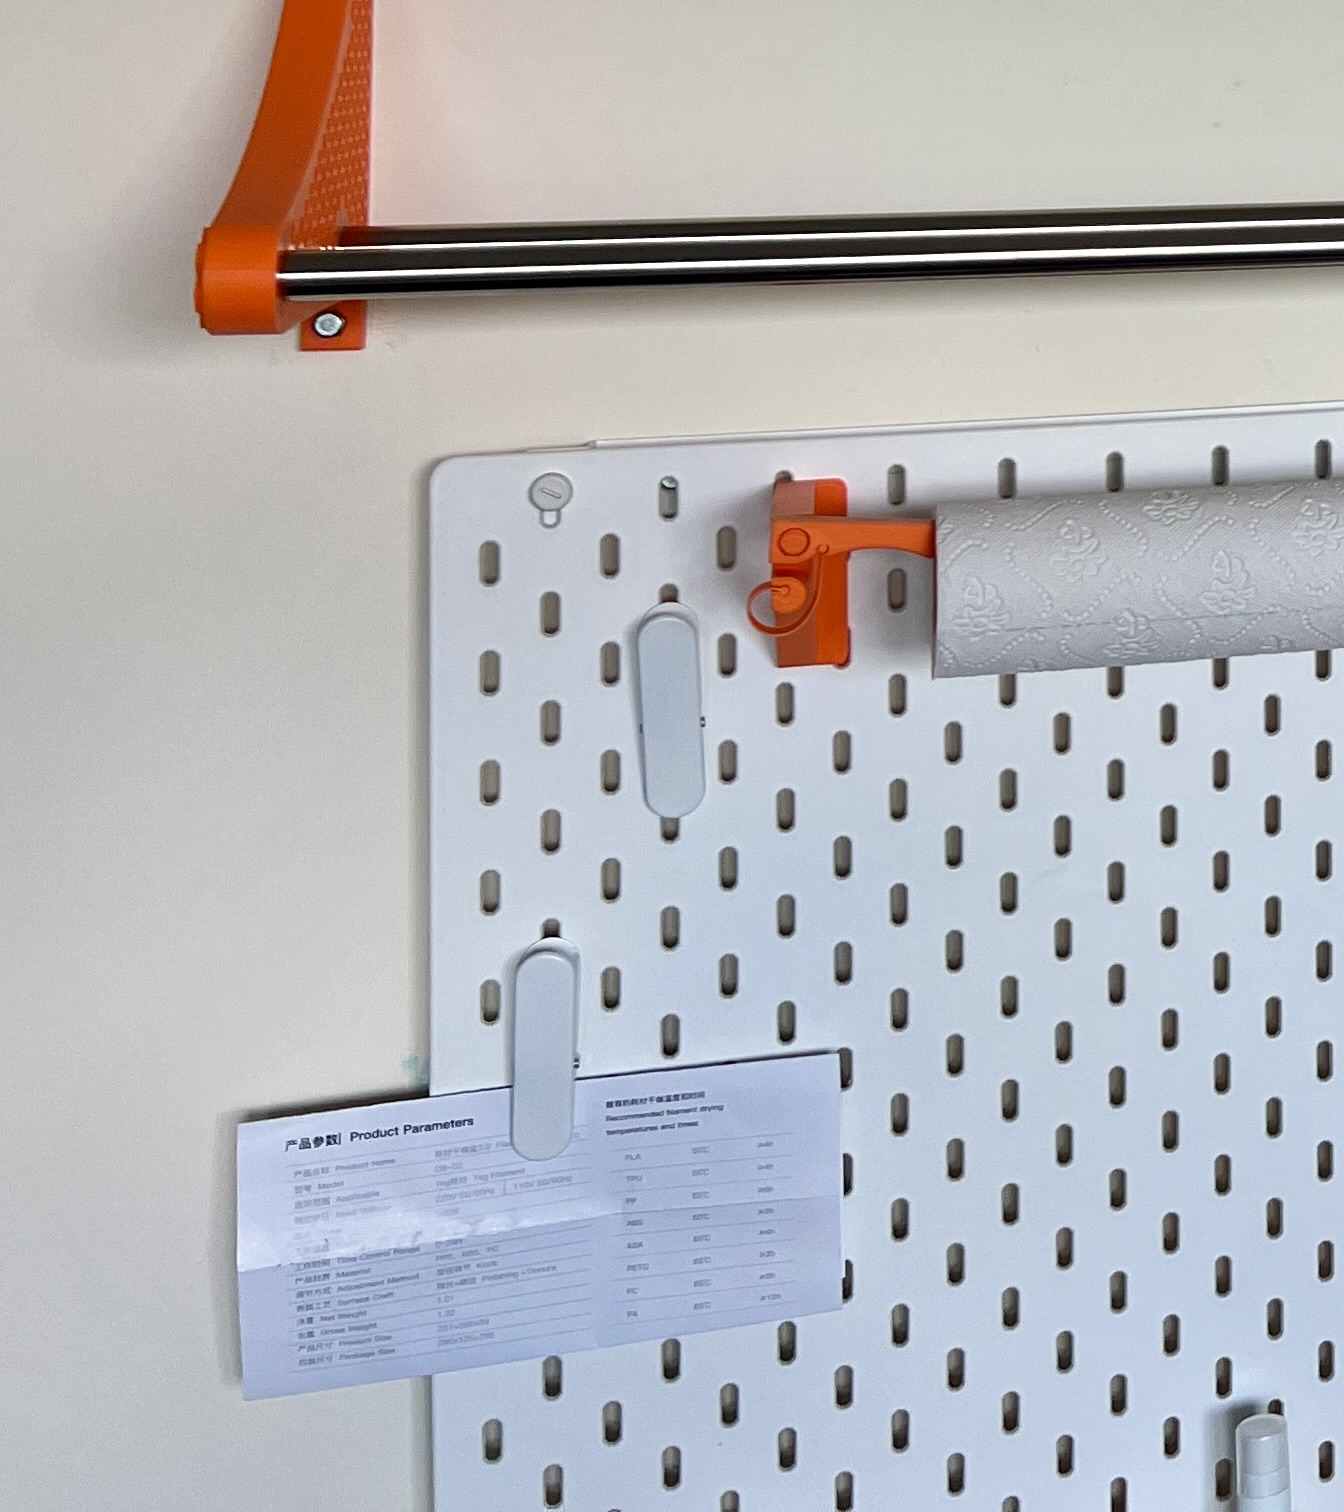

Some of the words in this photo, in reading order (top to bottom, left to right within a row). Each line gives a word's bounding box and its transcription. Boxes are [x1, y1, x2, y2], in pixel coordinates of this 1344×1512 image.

[605, 1110, 665, 1122] Recommended
[699, 1104, 725, 1114] drying
[350, 1127, 400, 1142] Product
[404, 1117, 474, 1135] Parameters
[660, 1122, 676, 1131] and
